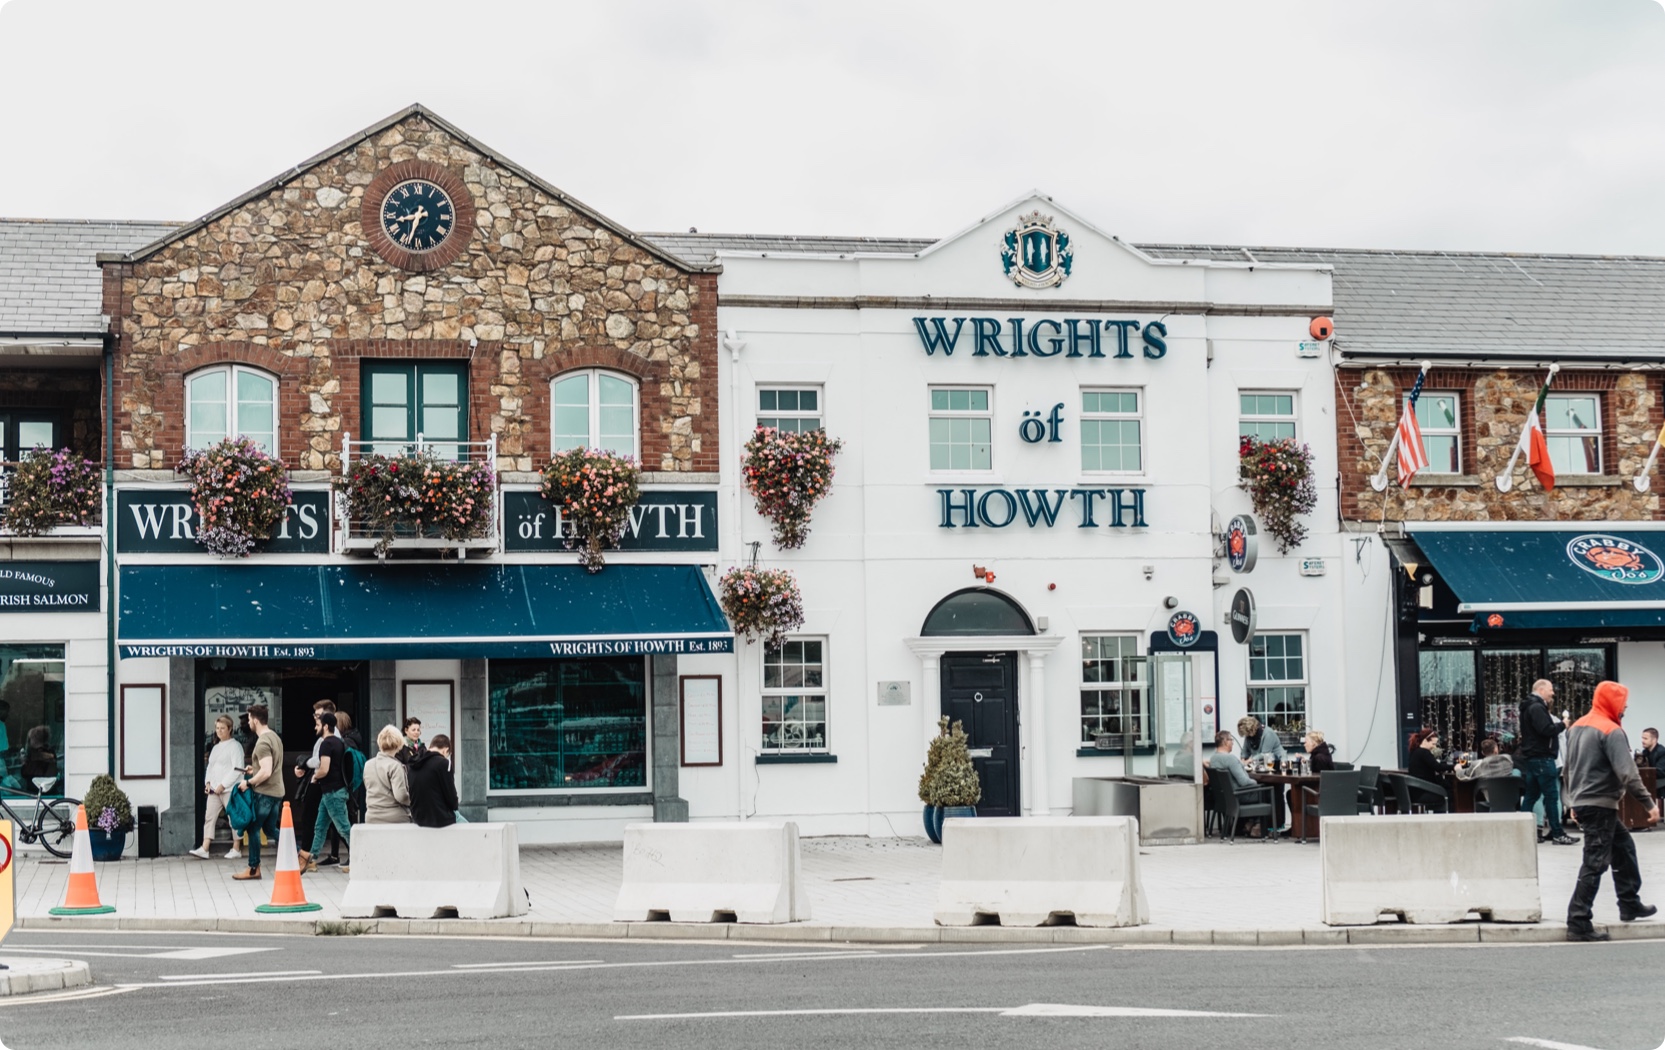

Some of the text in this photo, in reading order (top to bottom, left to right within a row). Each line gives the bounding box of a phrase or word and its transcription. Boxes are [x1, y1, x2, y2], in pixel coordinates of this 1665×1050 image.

[912, 316, 1168, 360] WRIGHTS
[1018, 402, 1065, 443] öf
[937, 488, 1149, 528] HOWTH
[518, 513, 546, 539] öf
[552, 504, 705, 539] HWTH
[1573, 538, 1645, 555] CRABBY
[14, 571, 56, 588] FAMOUS
[33, 593, 89, 606] SALMON
[127, 646, 315, 658] WRIGHTS OF HOWTH Est. 1893
[550, 640, 728, 655] WRIGHTS OF HOWTH Est. 1893
